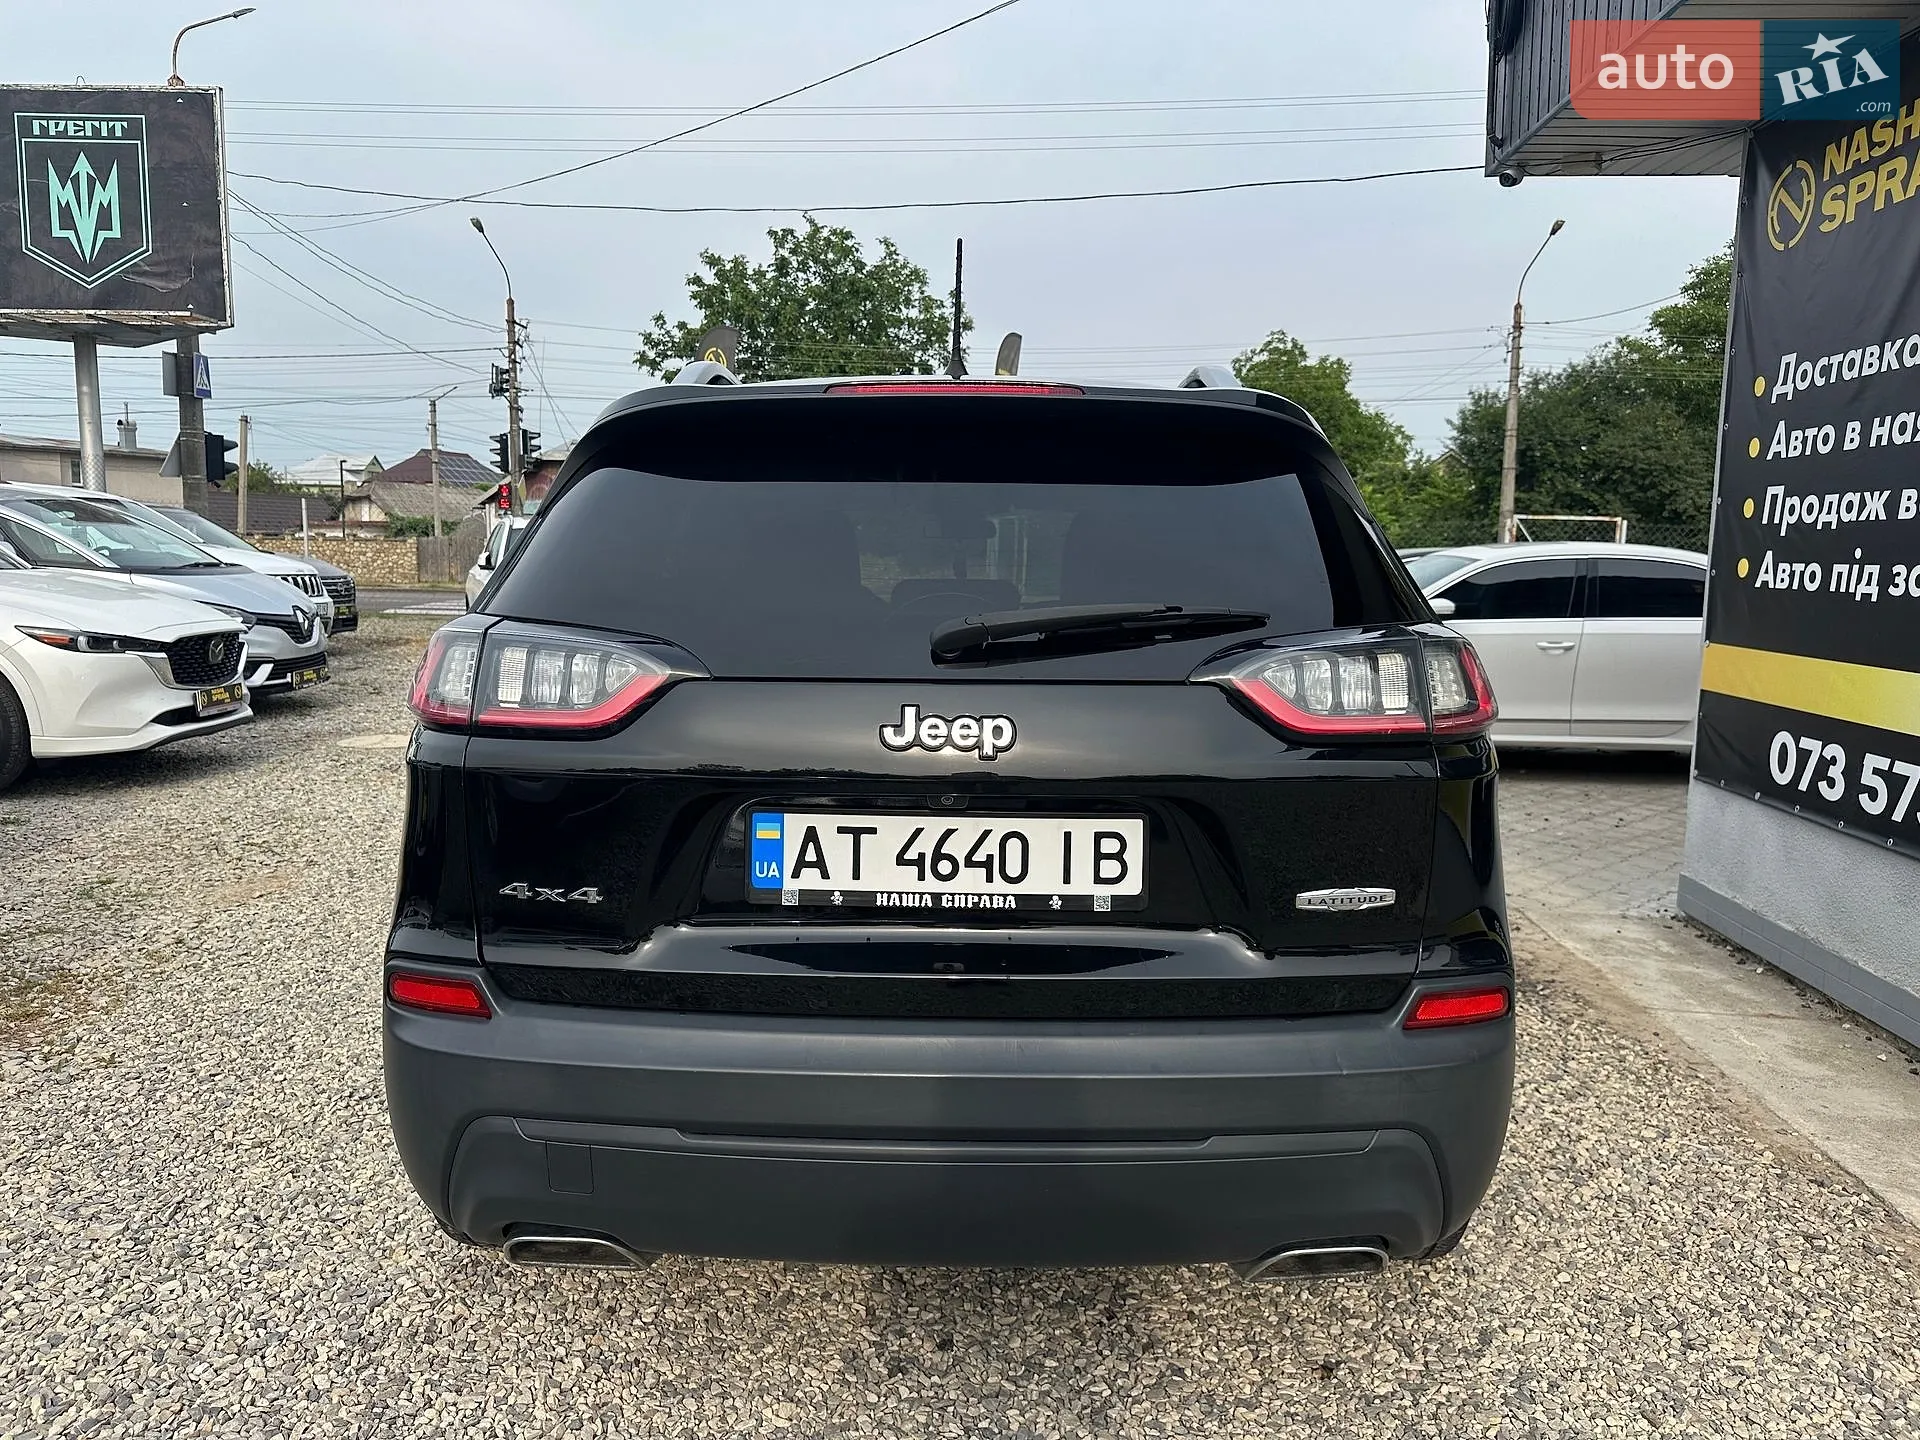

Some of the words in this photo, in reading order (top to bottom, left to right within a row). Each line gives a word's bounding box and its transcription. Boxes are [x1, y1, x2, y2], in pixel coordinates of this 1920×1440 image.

[1766, 420, 1836, 460] Авто
[1843, 420, 1861, 451] в
[1869, 411, 1920, 448] на
[1762, 485, 1891, 536] Продаж
[1754, 550, 1822, 592] Авто
[1829, 547, 1881, 602] під
[880, 703, 1017, 761] Jeep
[1769, 731, 1846, 801] 073
[1858, 753, 1920, 823] 57
[755, 861, 780, 878] UA
[790, 825, 878, 881] AT
[895, 827, 1030, 884] 4640
[499, 882, 604, 904] 4x4
[875, 892, 933, 907] НАША
[941, 893, 1017, 909] СПРАВА
[1307, 894, 1387, 905] LATITUDE
